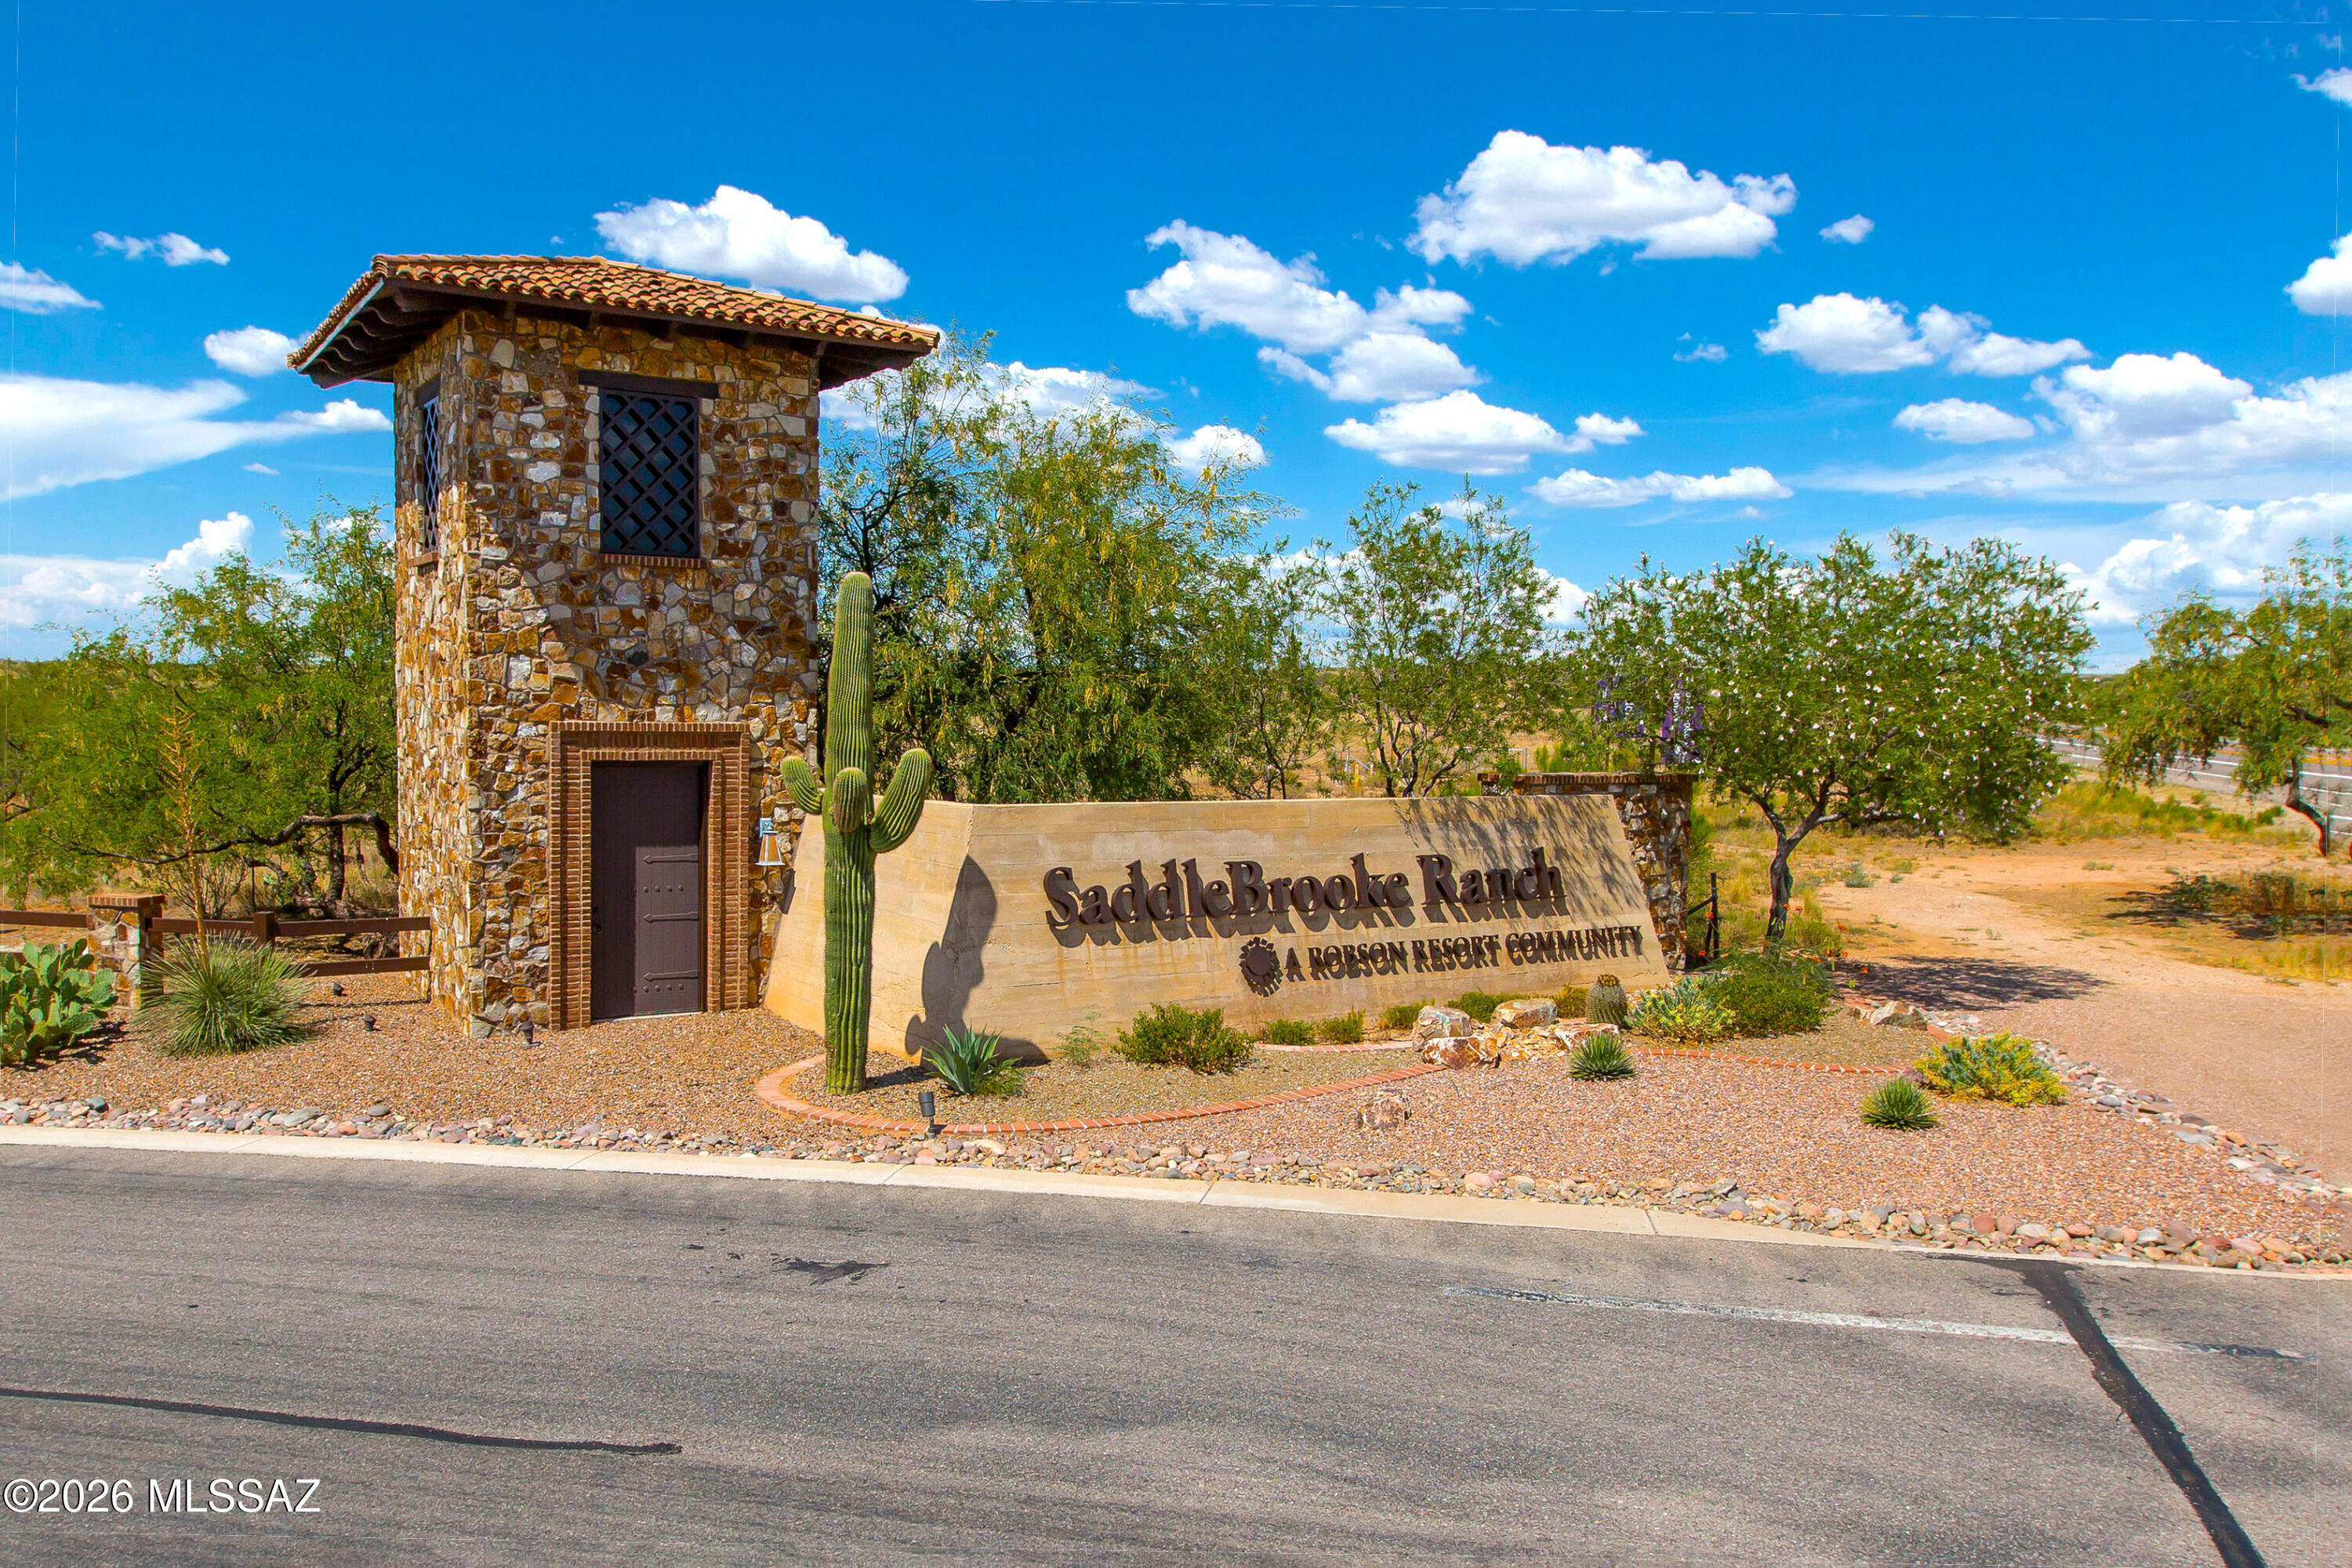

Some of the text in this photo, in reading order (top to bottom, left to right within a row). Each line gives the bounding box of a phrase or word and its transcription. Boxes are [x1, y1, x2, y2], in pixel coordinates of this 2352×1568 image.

[1044, 847, 1567, 925] SaddleBrooke Ranch
[1284, 925, 1642, 969] A ROBSON RESORT COMMUNITY
